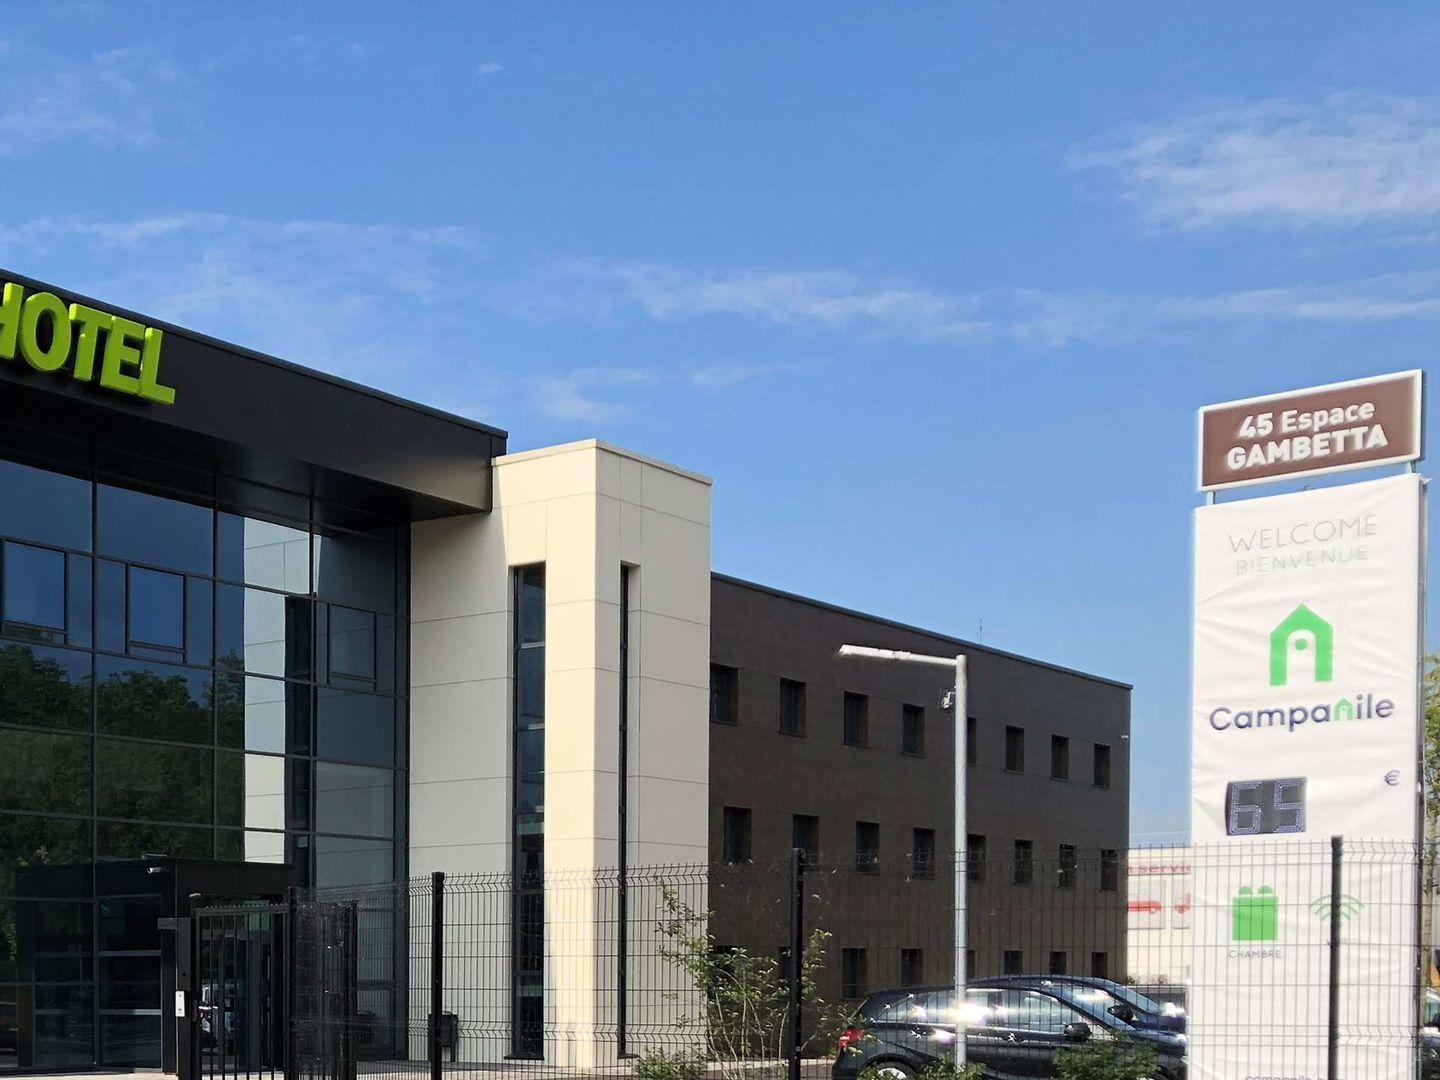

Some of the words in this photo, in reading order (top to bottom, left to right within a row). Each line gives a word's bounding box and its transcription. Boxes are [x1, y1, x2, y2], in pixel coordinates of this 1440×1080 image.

[1239, 412, 1274, 438] 45
[1281, 402, 1375, 433] Espace
[1227, 424, 1389, 470] GAMBETTA
[1228, 514, 1378, 553] WELCOME
[1235, 543, 1369, 576] BIENVENUE
[1209, 693, 1395, 733] Campanile
[1384, 769, 1401, 786] €
[1229, 949, 1283, 959] CHAMBRE
